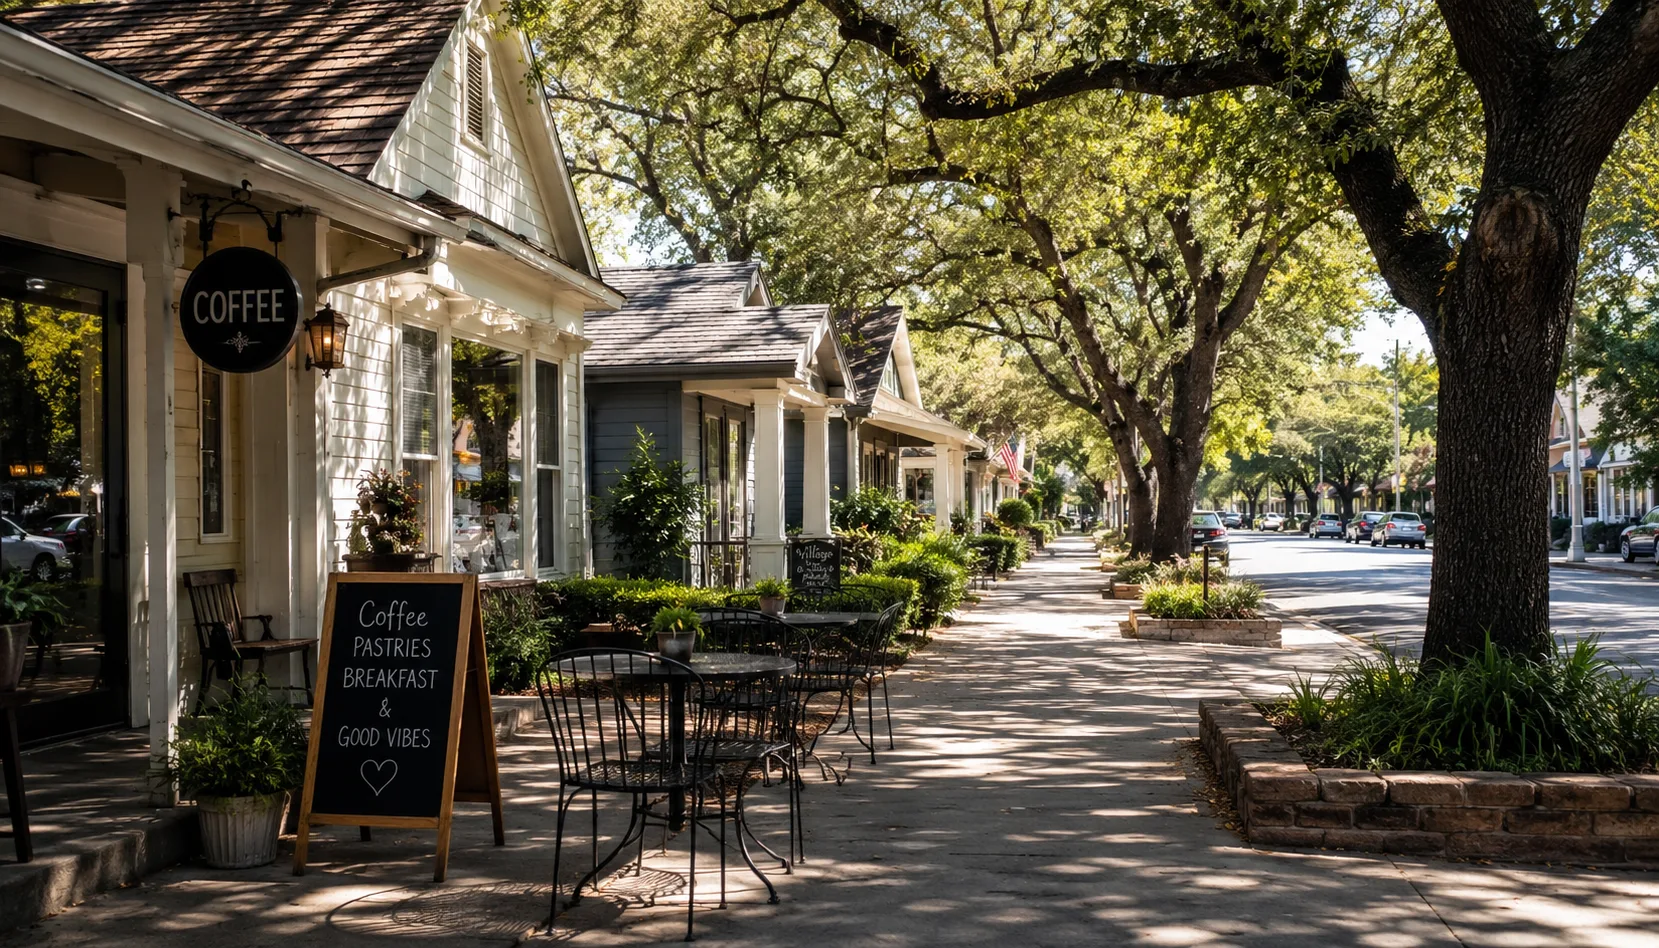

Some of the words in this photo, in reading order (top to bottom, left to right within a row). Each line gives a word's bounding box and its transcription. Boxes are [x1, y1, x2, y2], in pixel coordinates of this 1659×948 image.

[193, 289, 285, 324] COFFEE
[359, 600, 429, 631] Coffee
[353, 636, 431, 658] PASTRIES
[343, 667, 439, 689] BREAKFAST
[379, 697, 392, 718] &
[338, 725, 380, 748] GOOD
[387, 728, 431, 748] VIBES
